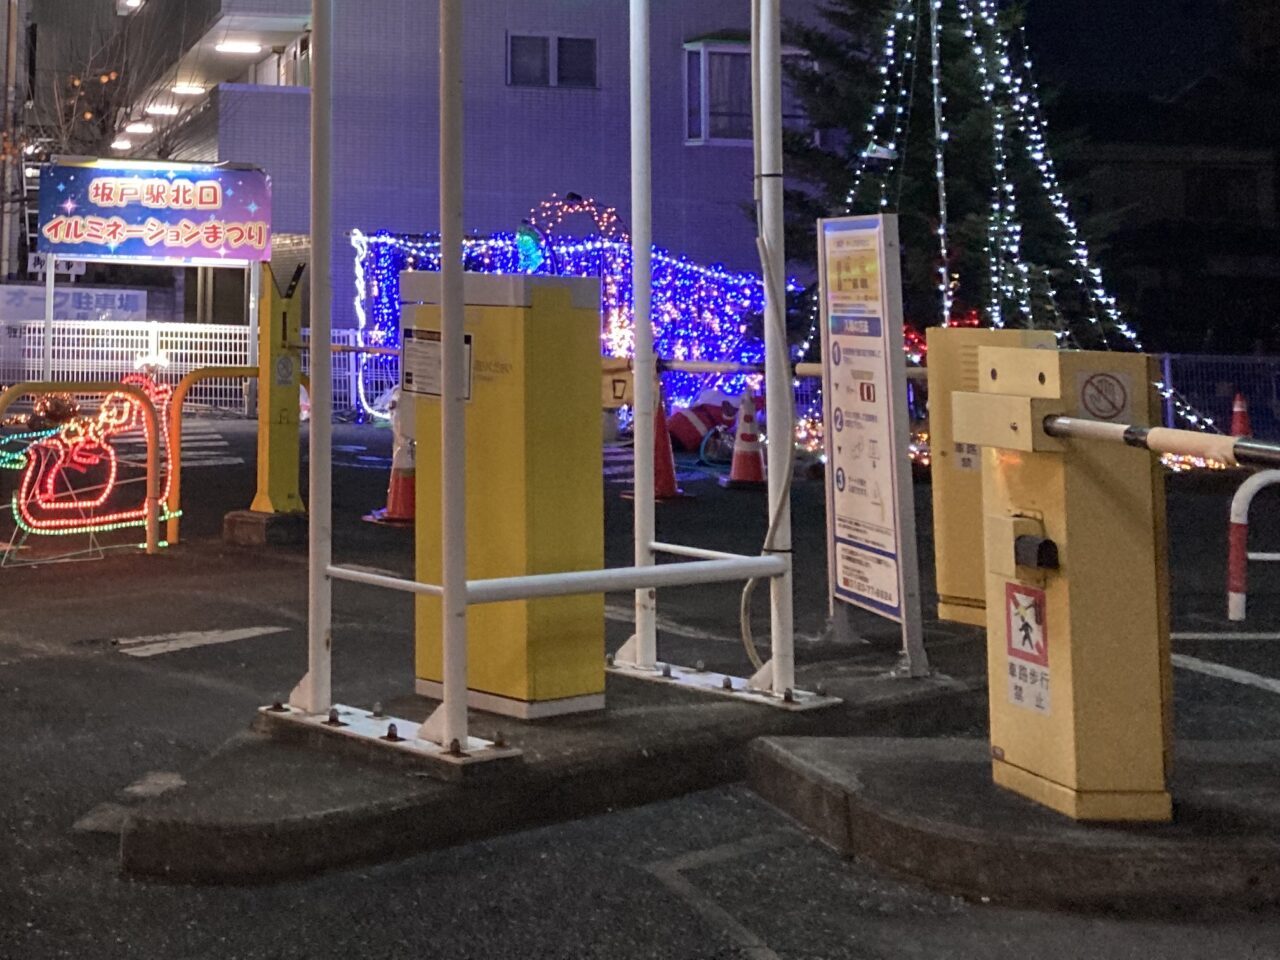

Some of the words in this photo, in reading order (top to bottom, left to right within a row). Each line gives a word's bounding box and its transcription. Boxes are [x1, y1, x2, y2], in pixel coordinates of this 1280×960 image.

[90, 180, 221, 208] 坂戸駅北口
[44, 217, 266, 247] イルミネーションまつり
